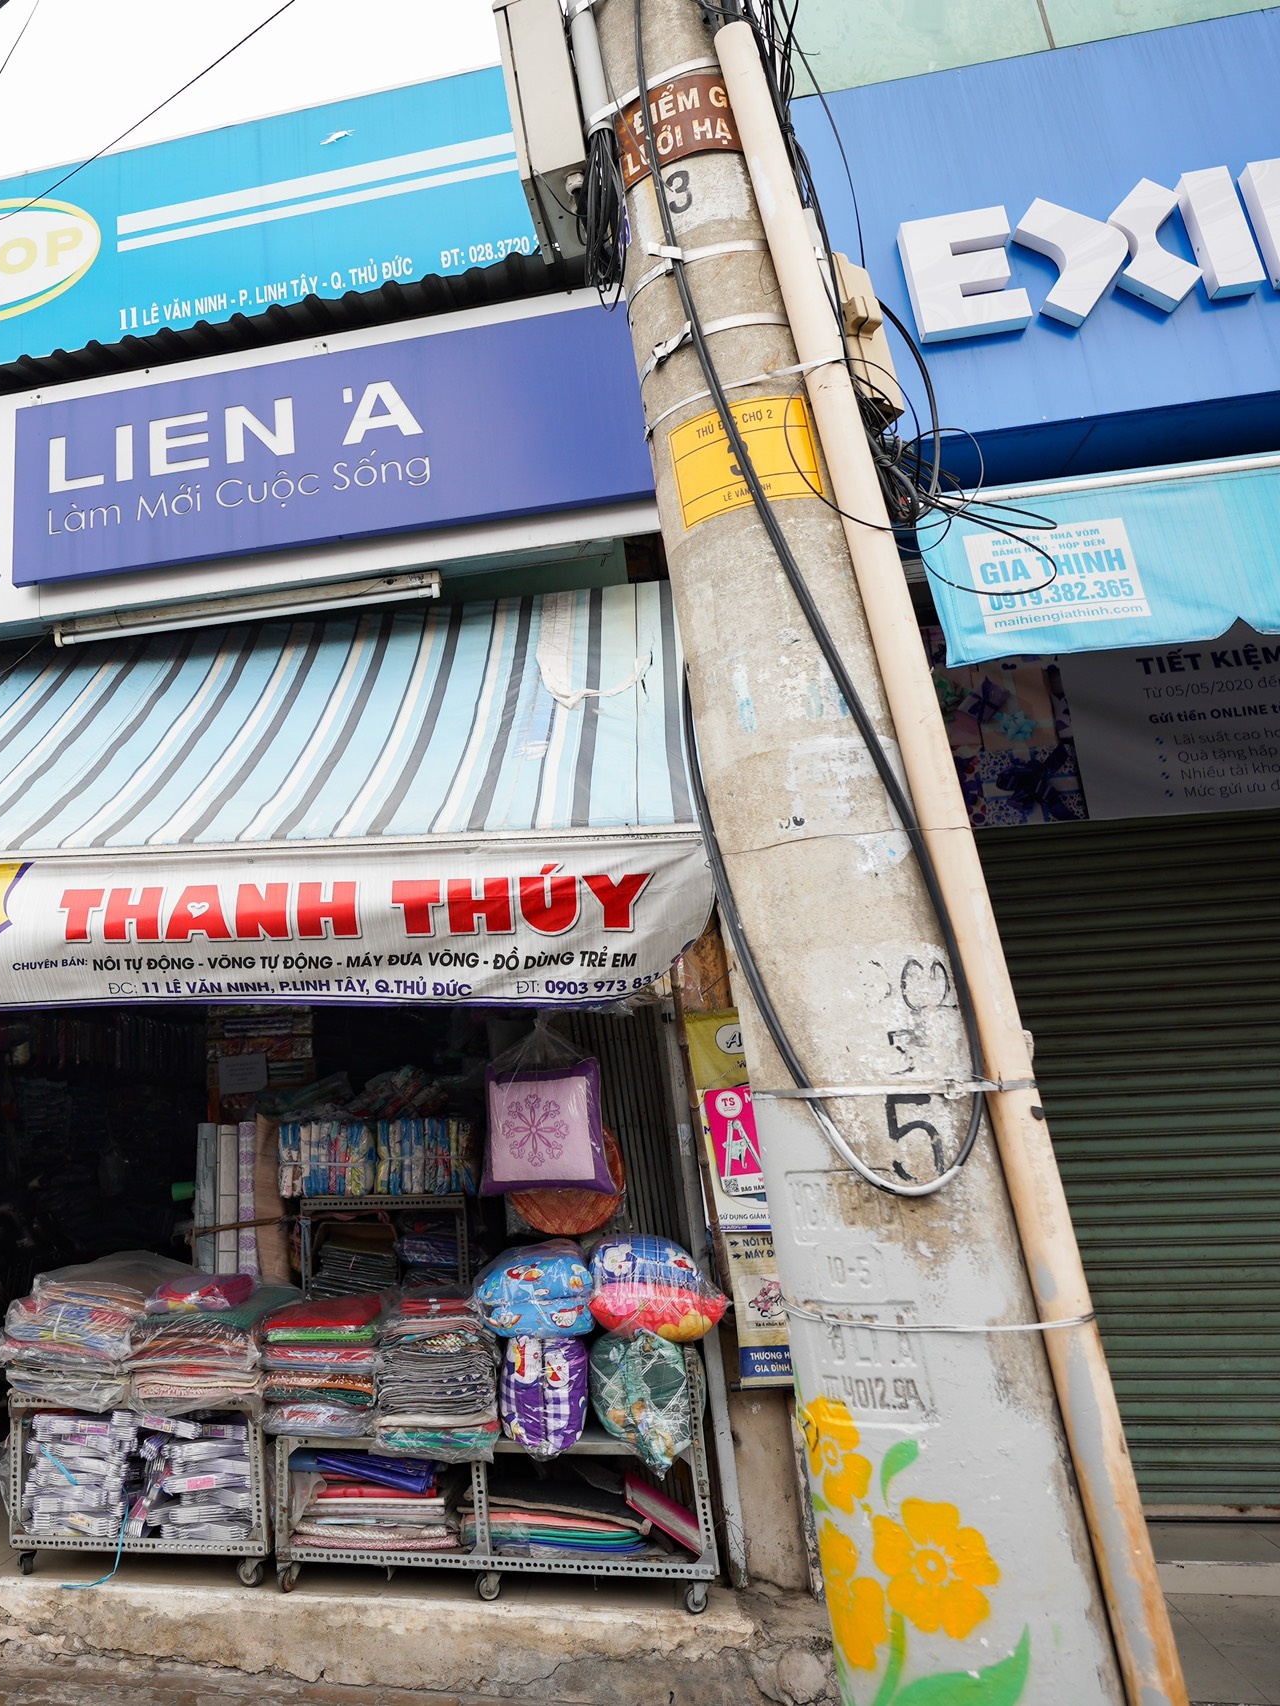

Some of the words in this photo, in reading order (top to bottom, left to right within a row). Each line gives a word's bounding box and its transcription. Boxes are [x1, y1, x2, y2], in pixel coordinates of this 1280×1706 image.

[665, 170, 693, 214] 3
[119, 306, 139, 331] 11
[142, 302, 160, 326] LÊ
[163, 297, 191, 321] VĂN
[195, 293, 227, 316] NINH
[238, 289, 252, 307] P.
[255, 282, 287, 304] LINH
[290, 273, 319, 298] TÂY
[330, 272, 346, 290] Q.
[348, 258, 378, 286] THỦ
[381, 254, 414, 280] ĐỨC
[440, 248, 466, 269] ĐT:
[469, 235, 530, 263] 028.3720
[766, 409, 774, 419] 2
[48, 395, 297, 494] LIEN
[47, 502, 122, 537] Làm
[136, 483, 202, 522] Mới
[214, 470, 321, 510] Cuộc
[332, 448, 432, 492] Sống
[979, 558, 1032, 586] GIA
[1036, 547, 1128, 580] THỊNH
[988, 577, 1136, 612] 0919.382.365
[994, 604, 1144, 629] maihiengiathinh.com
[1135, 648, 1202, 675] TIẾT
[1210, 704, 1269, 720] ONLINE
[57, 881, 362, 943] THANH
[390, 863, 656, 937] THÚY
[12, 957, 59, 972] CHUYÊN
[61, 956, 89, 968] BÁN:
[93, 955, 121, 972] NÔI
[124, 955, 144, 974] TỰ
[146, 954, 195, 975] ĐỘNG
[207, 954, 256, 971] VÕNG
[260, 955, 280, 974] TỰ
[282, 952, 333, 975] ĐỘNG
[346, 950, 384, 968] MÁY
[387, 951, 422, 967] ĐƯA
[427, 948, 480, 969] VÕNG
[492, 945, 520, 971] ĐỒ
[524, 949, 575, 970] DÙNG
[579, 945, 609, 968] TRẺ
[610, 952, 638, 968] EM
[108, 981, 139, 995] ĐC:
[141, 981, 161, 995] 11
[165, 977, 183, 994] LÊ
[184, 977, 224, 994] VĂN
[226, 981, 276, 996] NINH,
[279, 978, 331, 994] P.LINH
[335, 975, 370, 996] TÂY,
[375, 976, 428, 997] Q.THỦ
[431, 979, 473, 997] ĐỨC
[516, 980, 540, 994] ĐT:
[544, 979, 589, 995] 0903
[593, 980, 627, 993] 973
[721, 1097, 736, 1107] TS
[742, 1237, 760, 1247] NÔI
[744, 1249, 765, 1260] MÁY
[750, 1351, 783, 1361] THƯƠNG
[754, 1364, 770, 1373] GIA
